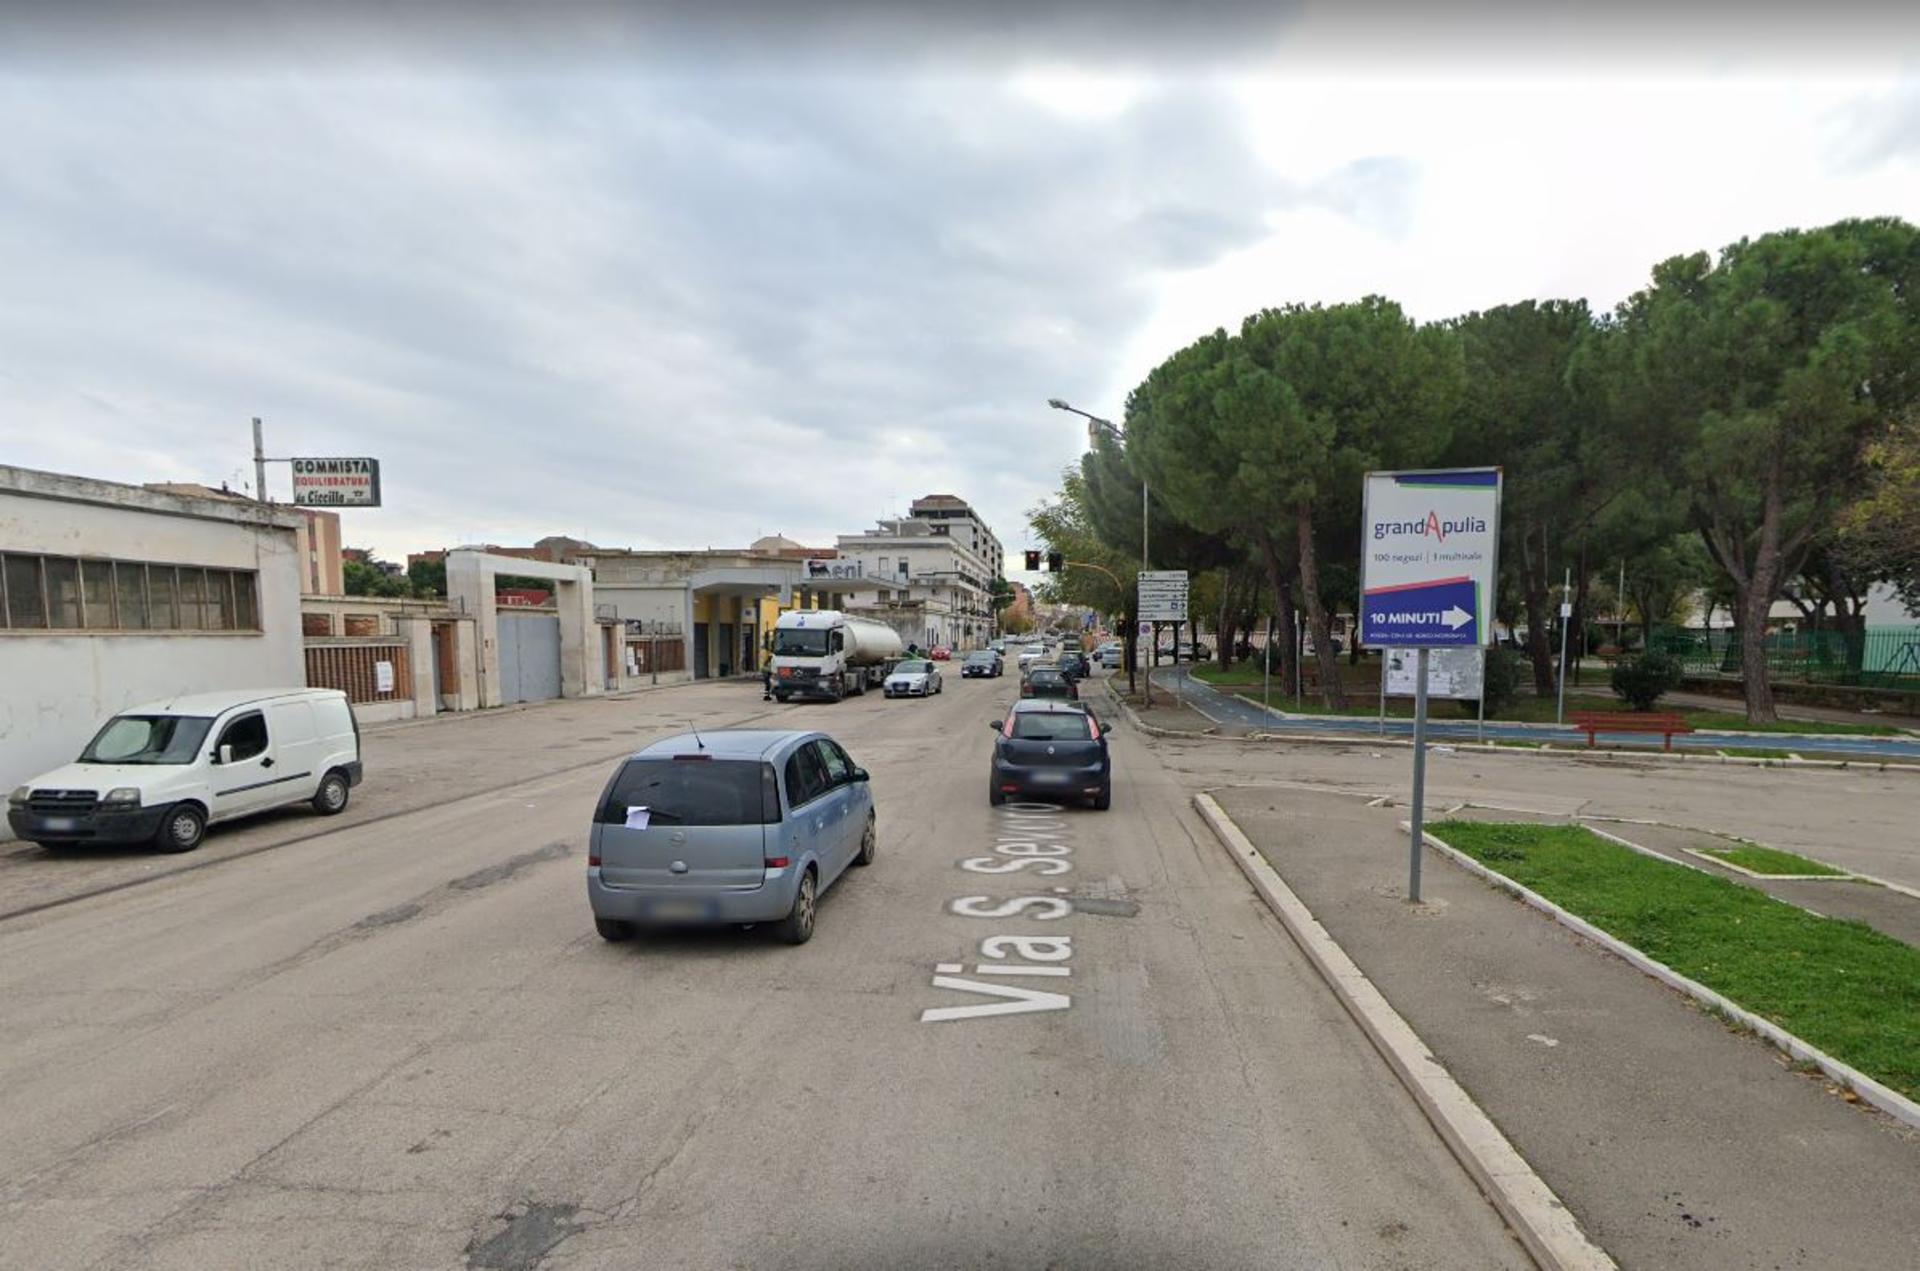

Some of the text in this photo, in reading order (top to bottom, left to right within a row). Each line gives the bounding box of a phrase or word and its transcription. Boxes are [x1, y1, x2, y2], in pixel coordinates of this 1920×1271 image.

[295, 460, 369, 473] GOMMISTA
[296, 476, 370, 486] EQUILIBRATURA
[1374, 510, 1486, 544] grandApulia
[1374, 552, 1390, 562] 100
[1392, 552, 1423, 565] negozi
[832, 560, 863, 579] eni
[1370, 612, 1440, 625] 10 MINUTI
